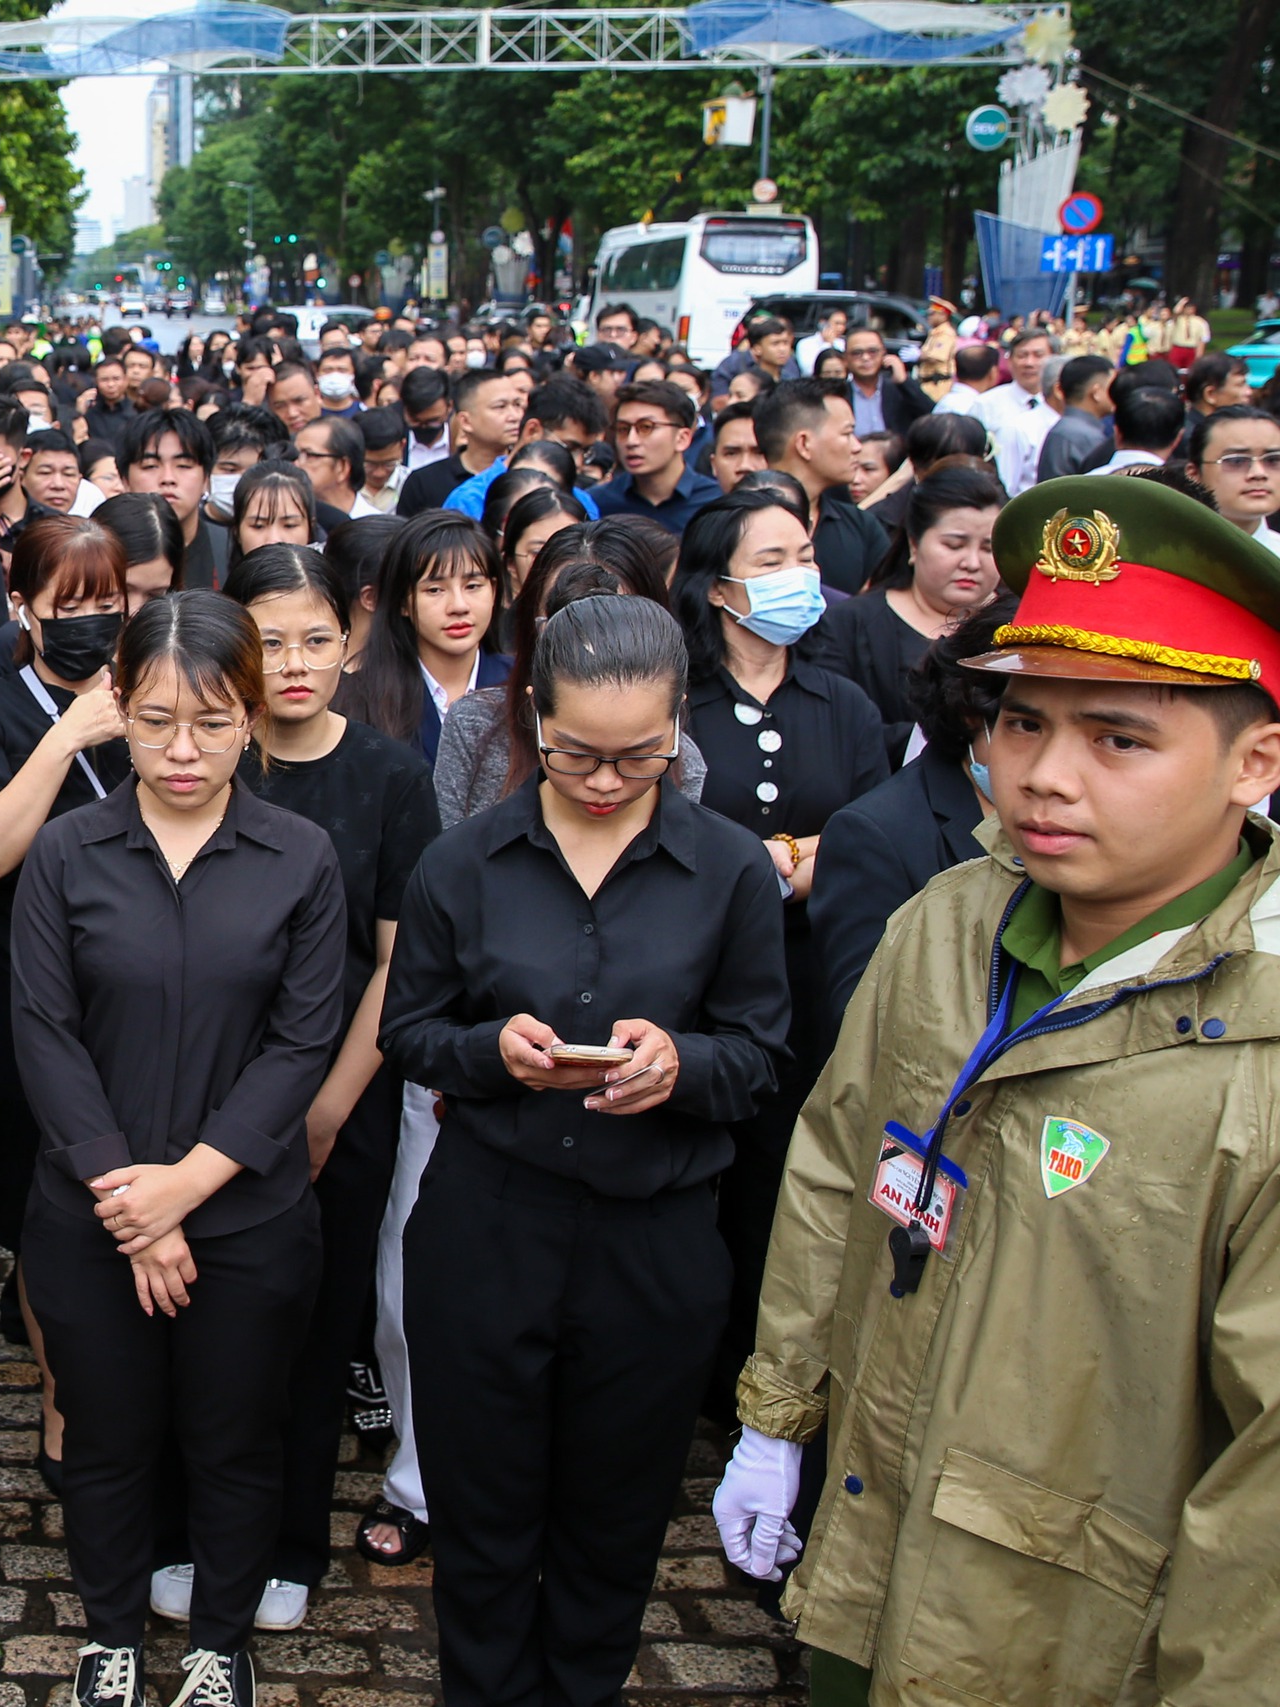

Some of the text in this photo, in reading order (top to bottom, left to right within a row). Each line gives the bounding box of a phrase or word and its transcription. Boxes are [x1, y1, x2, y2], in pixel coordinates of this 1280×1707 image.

[1049, 1149, 1082, 1180] TAKO
[880, 1183, 902, 1206] AN
[904, 1197, 940, 1234] NINH
